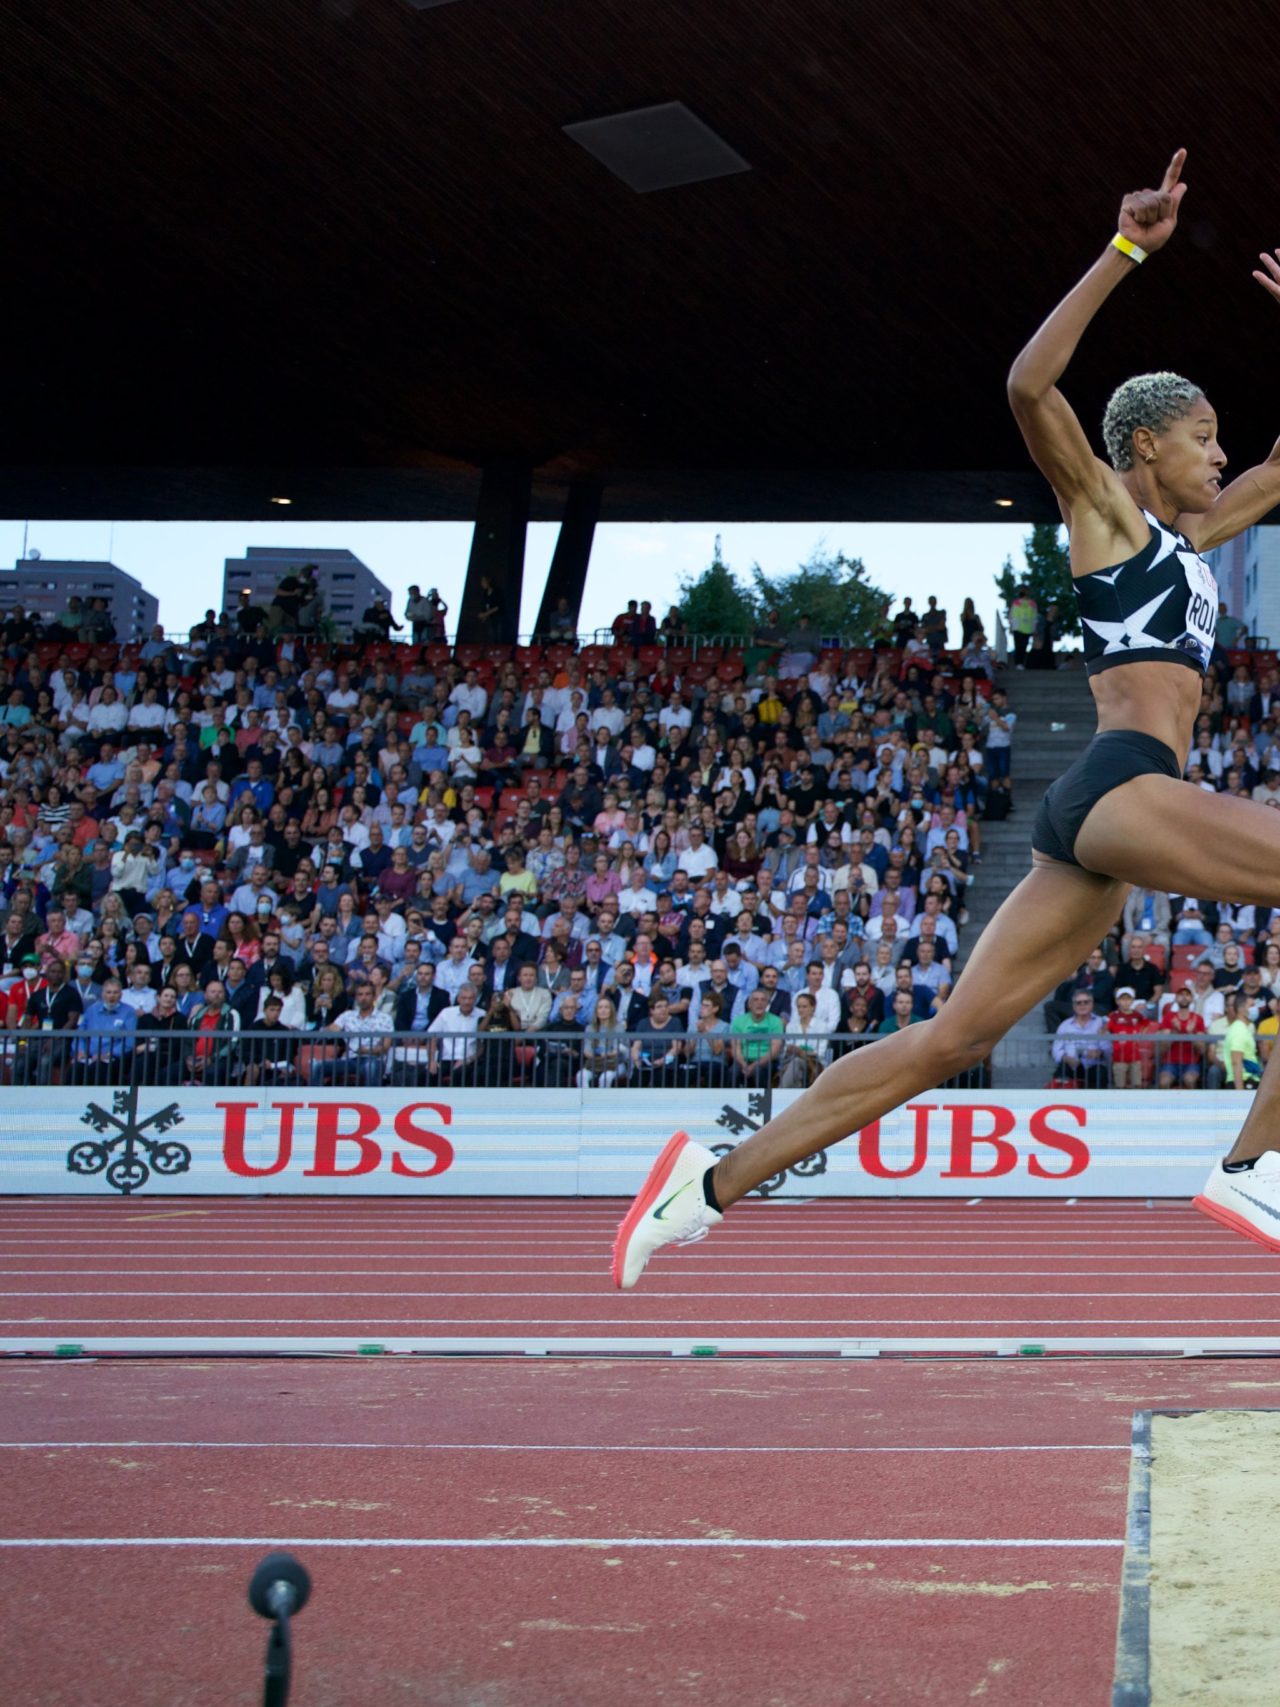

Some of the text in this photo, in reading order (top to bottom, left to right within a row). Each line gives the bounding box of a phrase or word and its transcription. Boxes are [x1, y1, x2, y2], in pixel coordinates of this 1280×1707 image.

[1189, 592, 1216, 638] ROJ
[215, 1102, 454, 1177] UBS
[858, 1104, 1091, 1179] UBS
